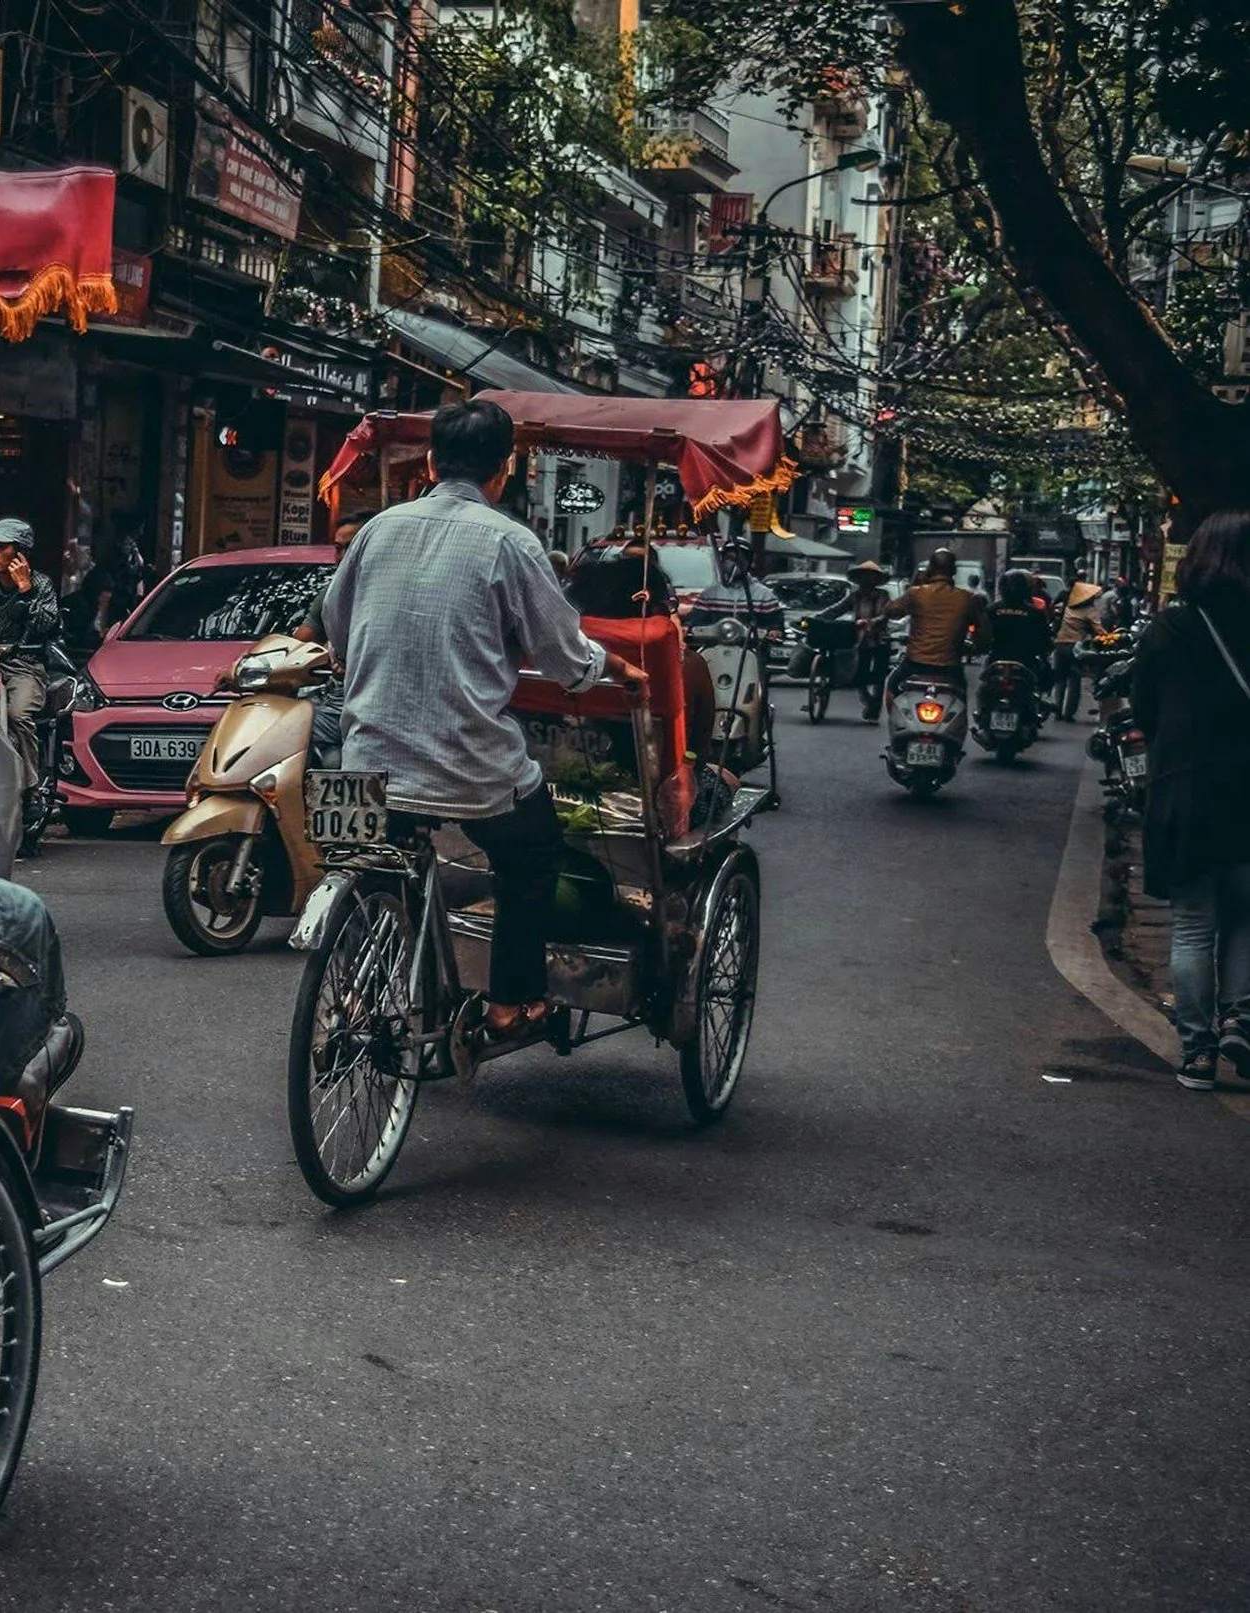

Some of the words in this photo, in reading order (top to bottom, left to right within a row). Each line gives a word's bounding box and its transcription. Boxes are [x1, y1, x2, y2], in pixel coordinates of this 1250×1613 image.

[282, 503, 310, 518] Kopi
[281, 530, 308, 542] Blue
[320, 778, 371, 807] 29XL
